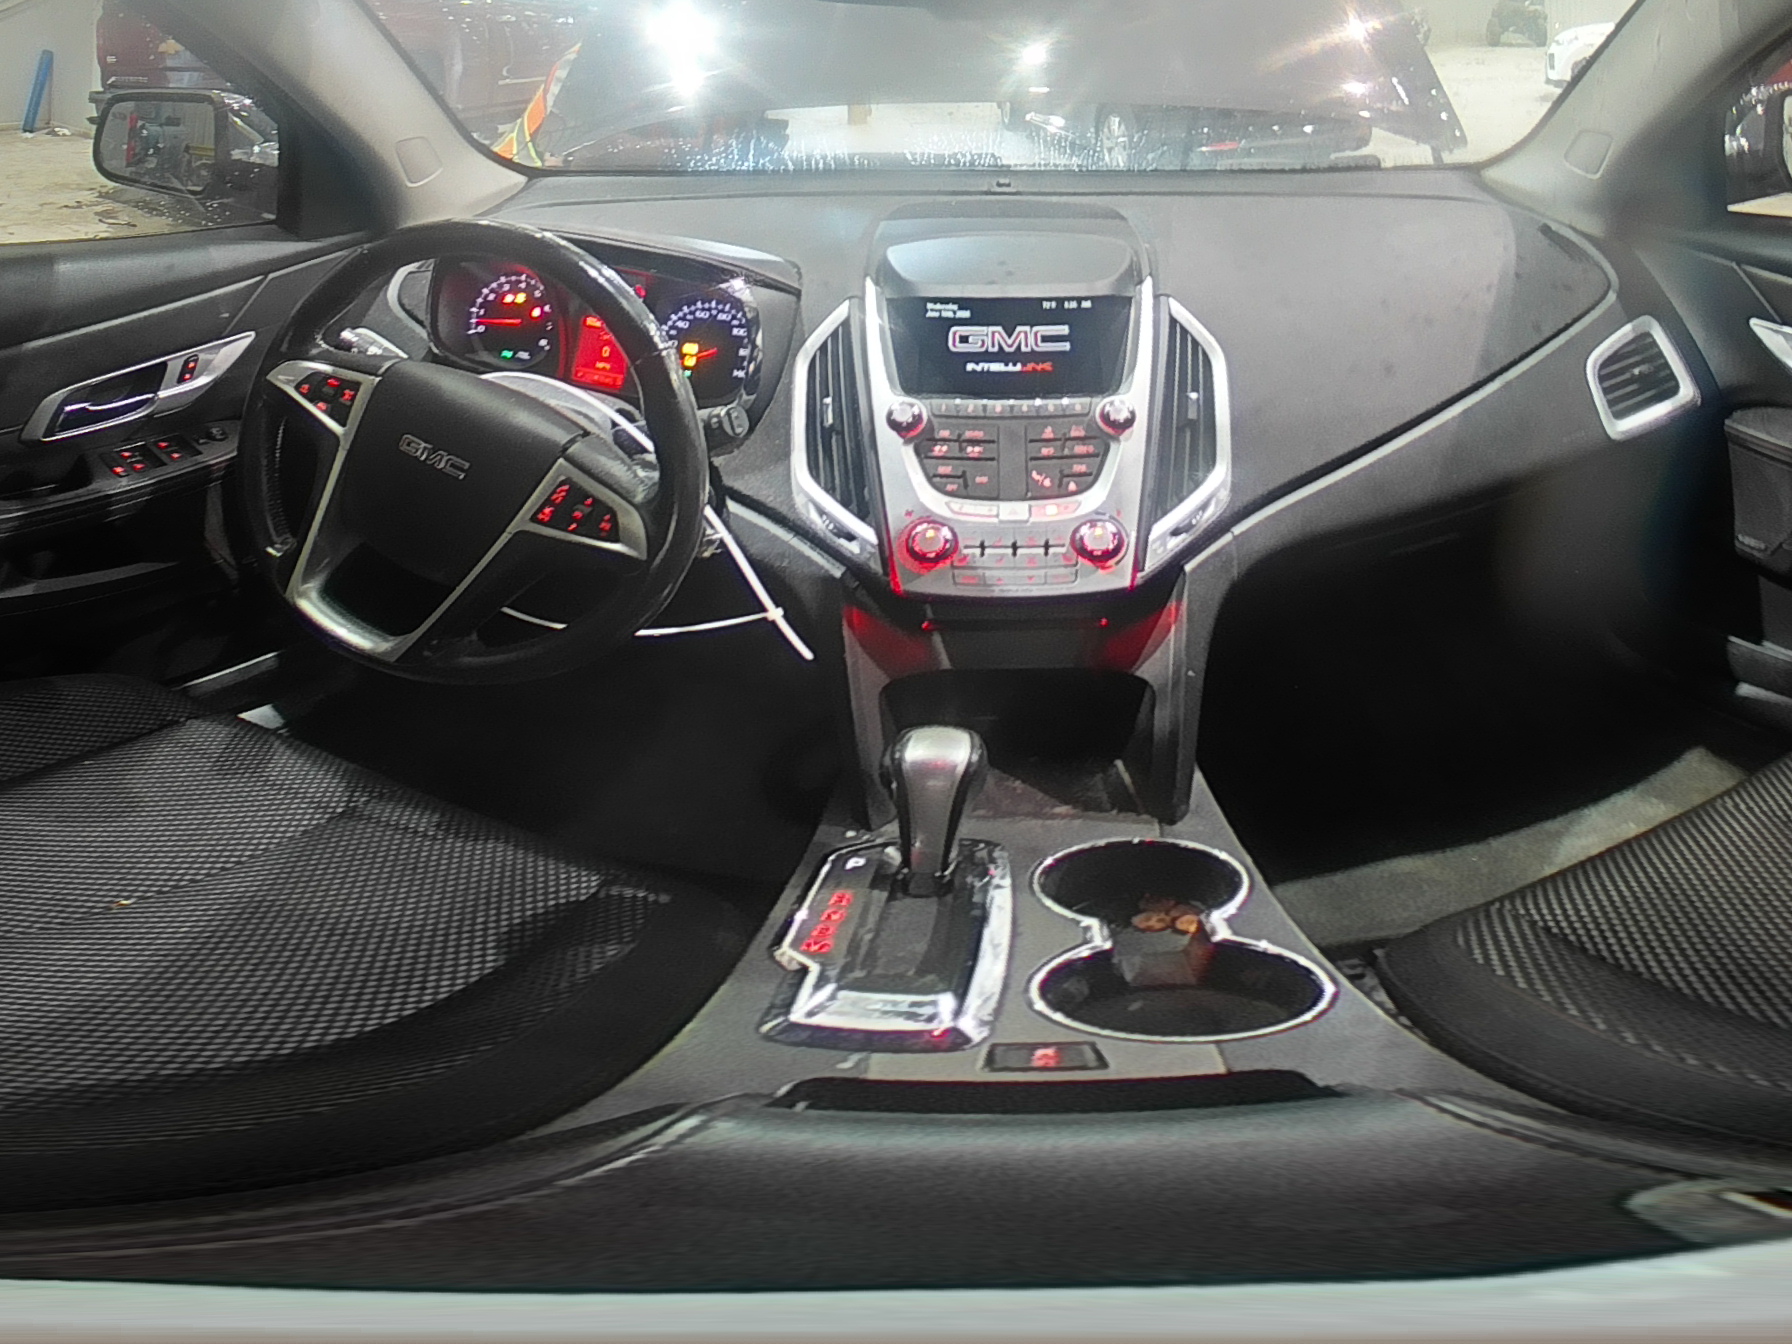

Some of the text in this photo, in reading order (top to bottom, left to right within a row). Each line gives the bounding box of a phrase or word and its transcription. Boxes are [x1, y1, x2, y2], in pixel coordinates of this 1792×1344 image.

[695, 310, 710, 319] 60
[716, 311, 732, 322] 80
[674, 319, 690, 330] 40
[948, 325, 1071, 353] GMC
[602, 346, 610, 358] 0
[399, 434, 470, 480] GMC
[844, 856, 867, 870] P
